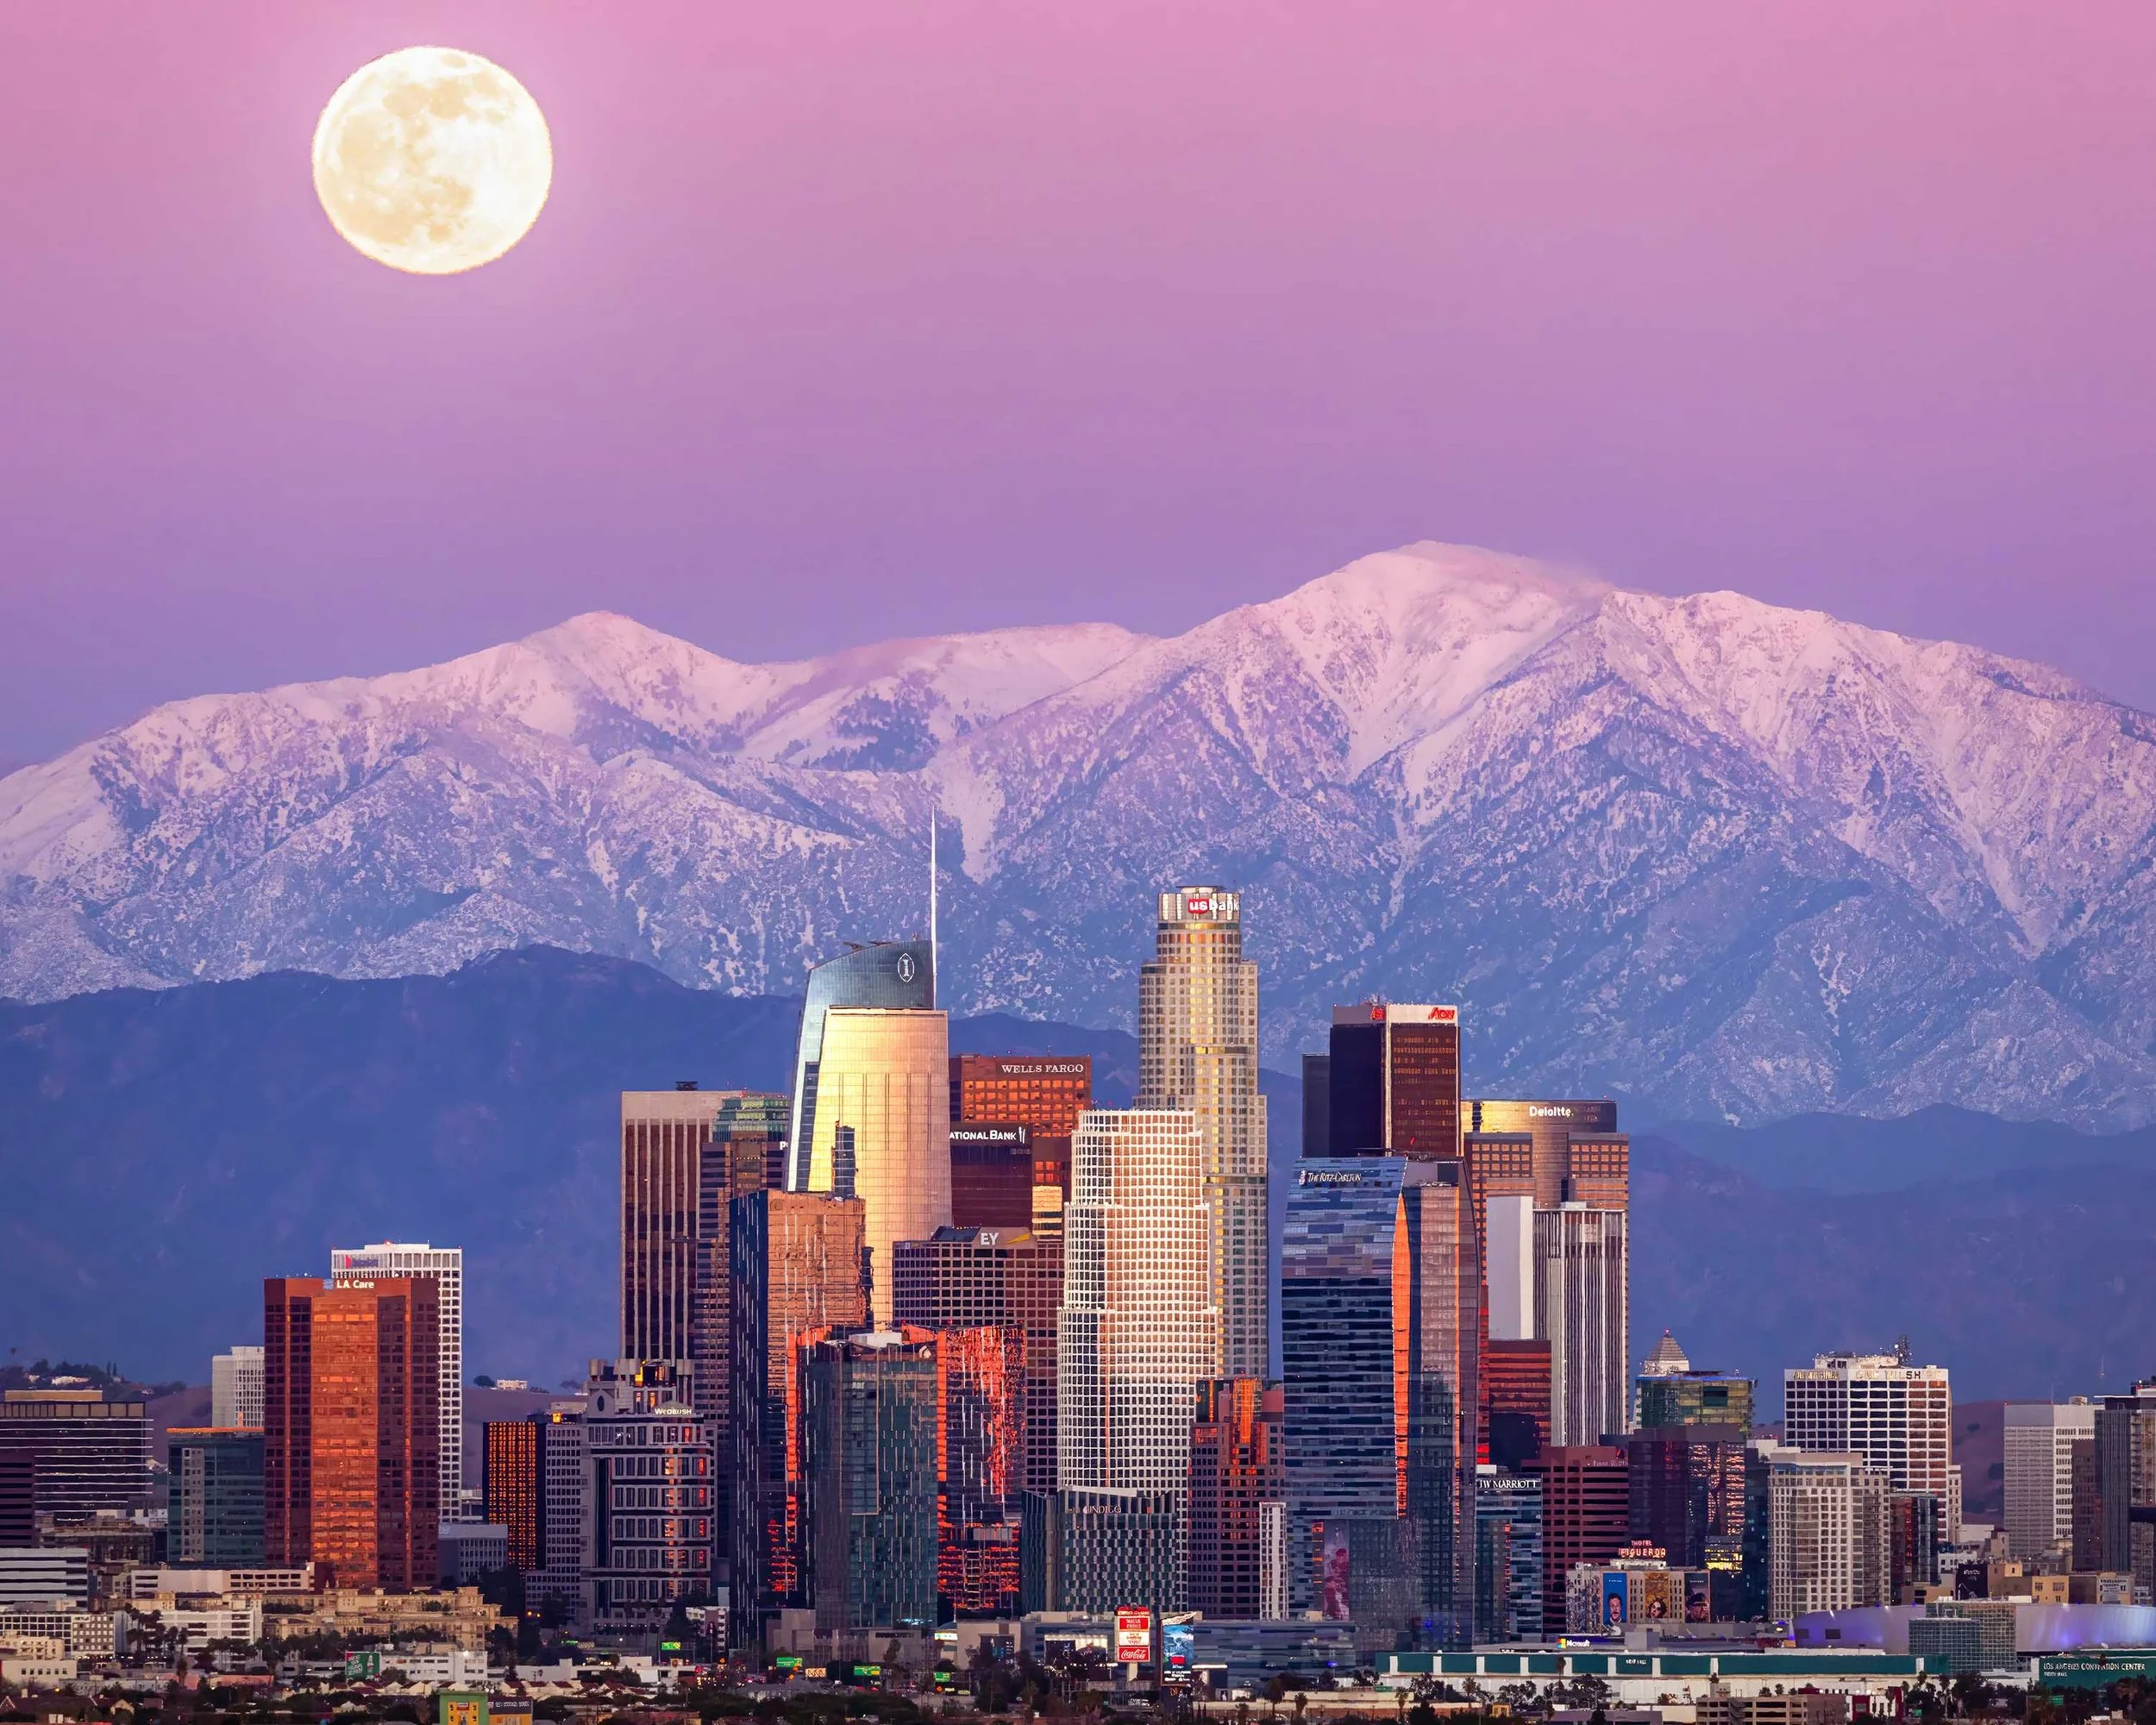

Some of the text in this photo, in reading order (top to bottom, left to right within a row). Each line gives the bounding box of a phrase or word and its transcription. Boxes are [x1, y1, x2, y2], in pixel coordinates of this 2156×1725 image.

[1001, 1063, 1084, 1074] WELLS FARGO
[950, 1131, 989, 1140] ATIONAL
[981, 1233, 1000, 1245] EY
[353, 1280, 375, 1289] Care
[1493, 1479, 1539, 1489] MARRIOTT
